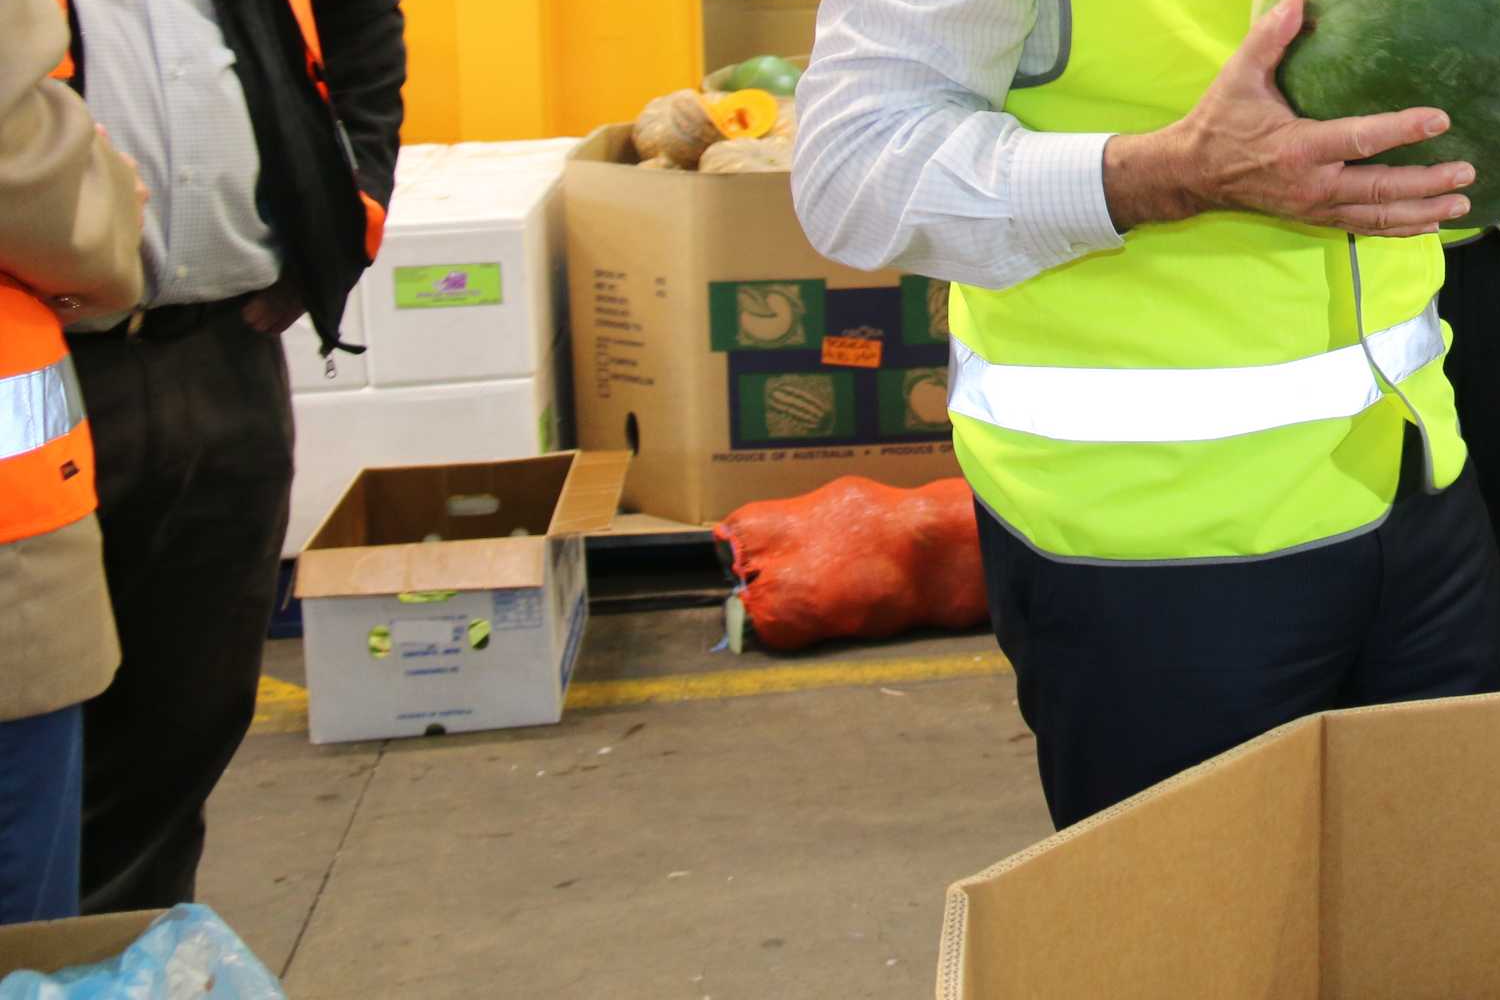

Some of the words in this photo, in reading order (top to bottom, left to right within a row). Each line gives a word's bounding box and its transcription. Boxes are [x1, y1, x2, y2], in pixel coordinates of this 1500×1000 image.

[712, 451, 766, 463] PRODUCE
[771, 450, 786, 461] OF
[792, 448, 854, 460] AUSTRALIA
[881, 444, 933, 456] PRODUCE
